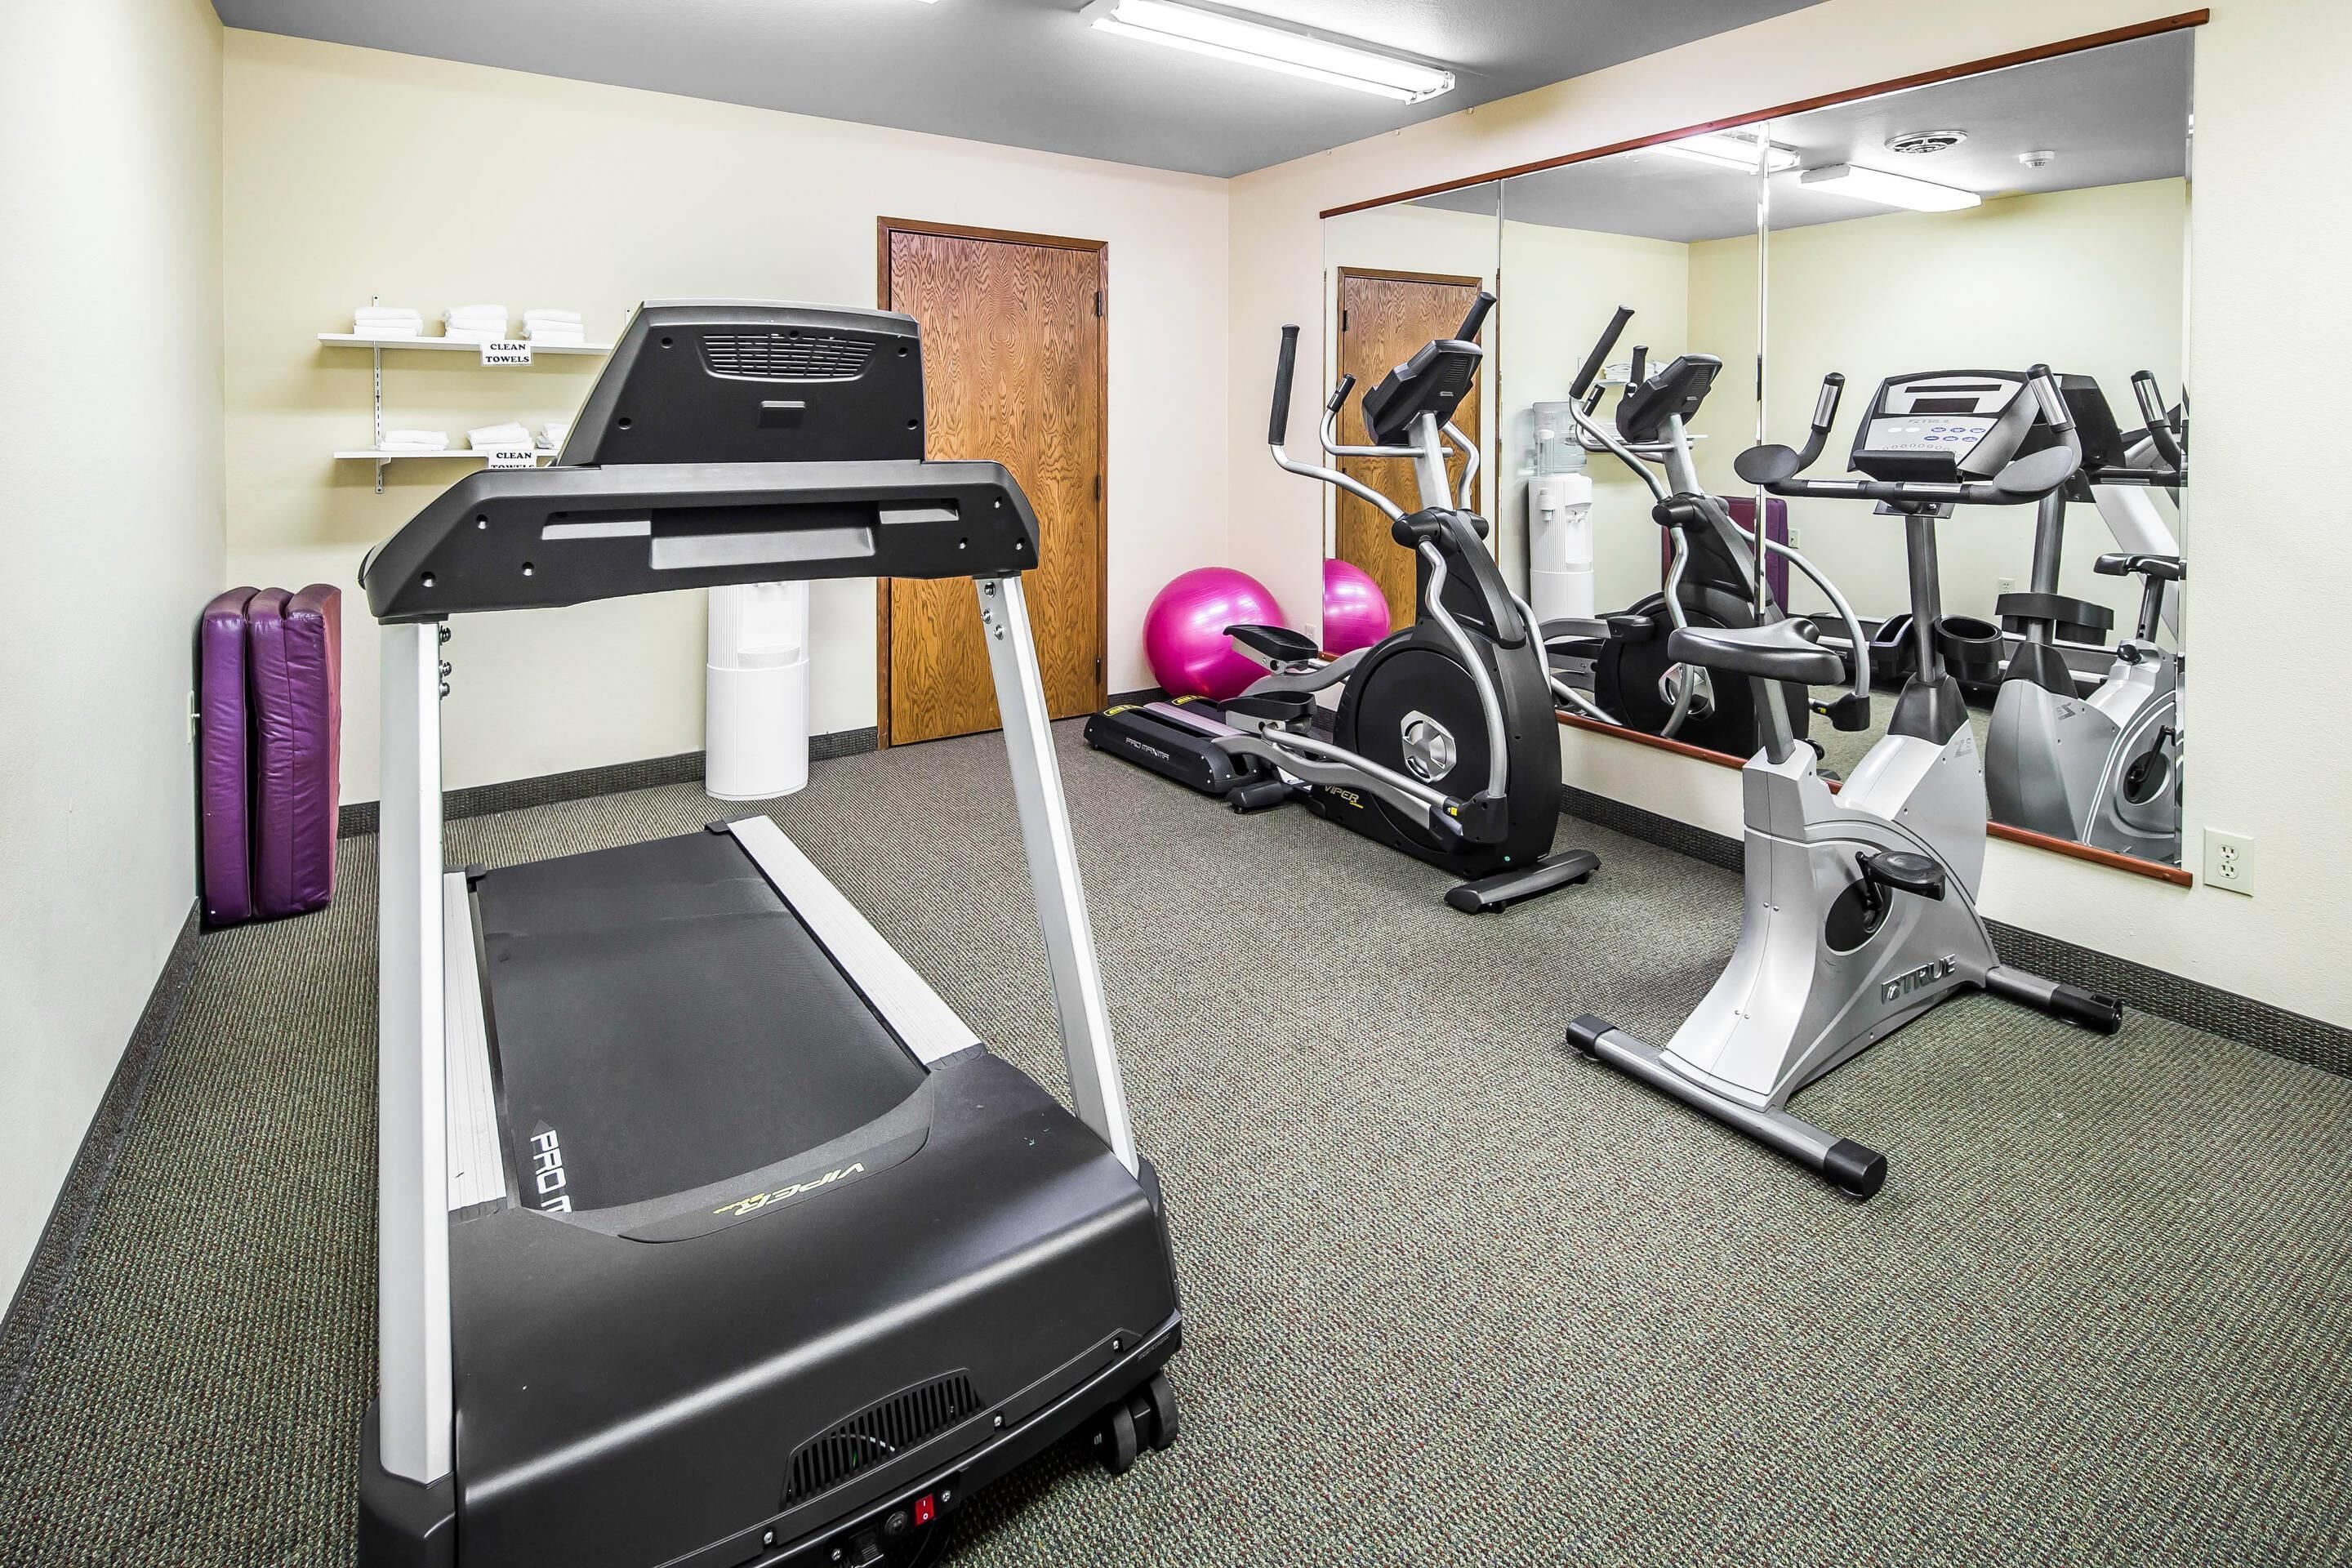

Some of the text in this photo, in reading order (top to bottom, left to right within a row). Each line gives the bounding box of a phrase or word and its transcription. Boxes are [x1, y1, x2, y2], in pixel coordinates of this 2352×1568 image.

[1125, 737, 1169, 760] PRO MAXIMA
[1325, 785, 1359, 803] VIPER
[1901, 954, 1956, 995] TRUE
[530, 1130, 566, 1194] PRO
[734, 1163, 865, 1216] VIPER
